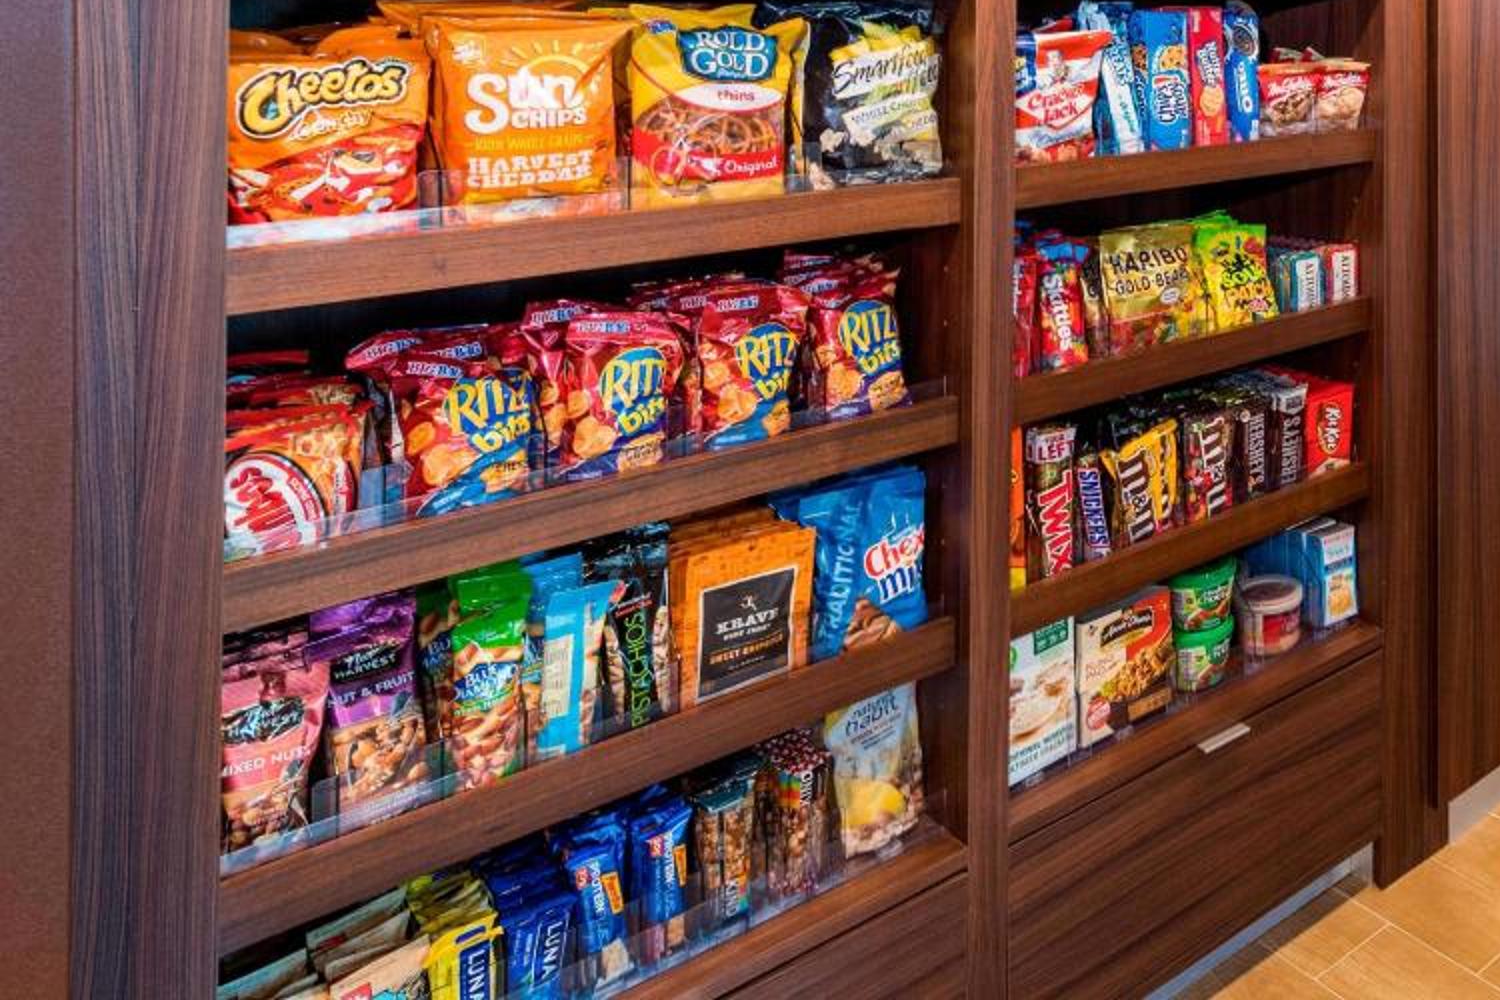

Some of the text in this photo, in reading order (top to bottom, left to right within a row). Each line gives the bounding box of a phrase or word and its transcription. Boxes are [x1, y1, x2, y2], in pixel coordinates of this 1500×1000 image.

[691, 49, 770, 77] GOLD
[696, 31, 766, 51] ROLD
[239, 58, 407, 136] Cheetos
[511, 106, 587, 129] CHIPS
[467, 165, 592, 188] CHEDDAR
[468, 150, 594, 174] HARVEST
[724, 155, 777, 174] Original
[1109, 247, 1188, 276] HARIBO
[841, 306, 897, 353] RITZ
[1043, 273, 1073, 352] Skittles
[739, 331, 798, 381] RITZ
[451, 375, 530, 434] RITZ
[472, 412, 531, 453] bits
[1038, 470, 1073, 576] TWIX
[1080, 471, 1109, 545] SNICKERS
[818, 502, 861, 639] TRADITIONAL
[865, 530, 925, 577] Chex
[333, 653, 396, 680] HARVEST
[375, 671, 415, 693] FRUIT
[625, 610, 651, 728] PISTACHIOS
[542, 920, 563, 981] LUNA
